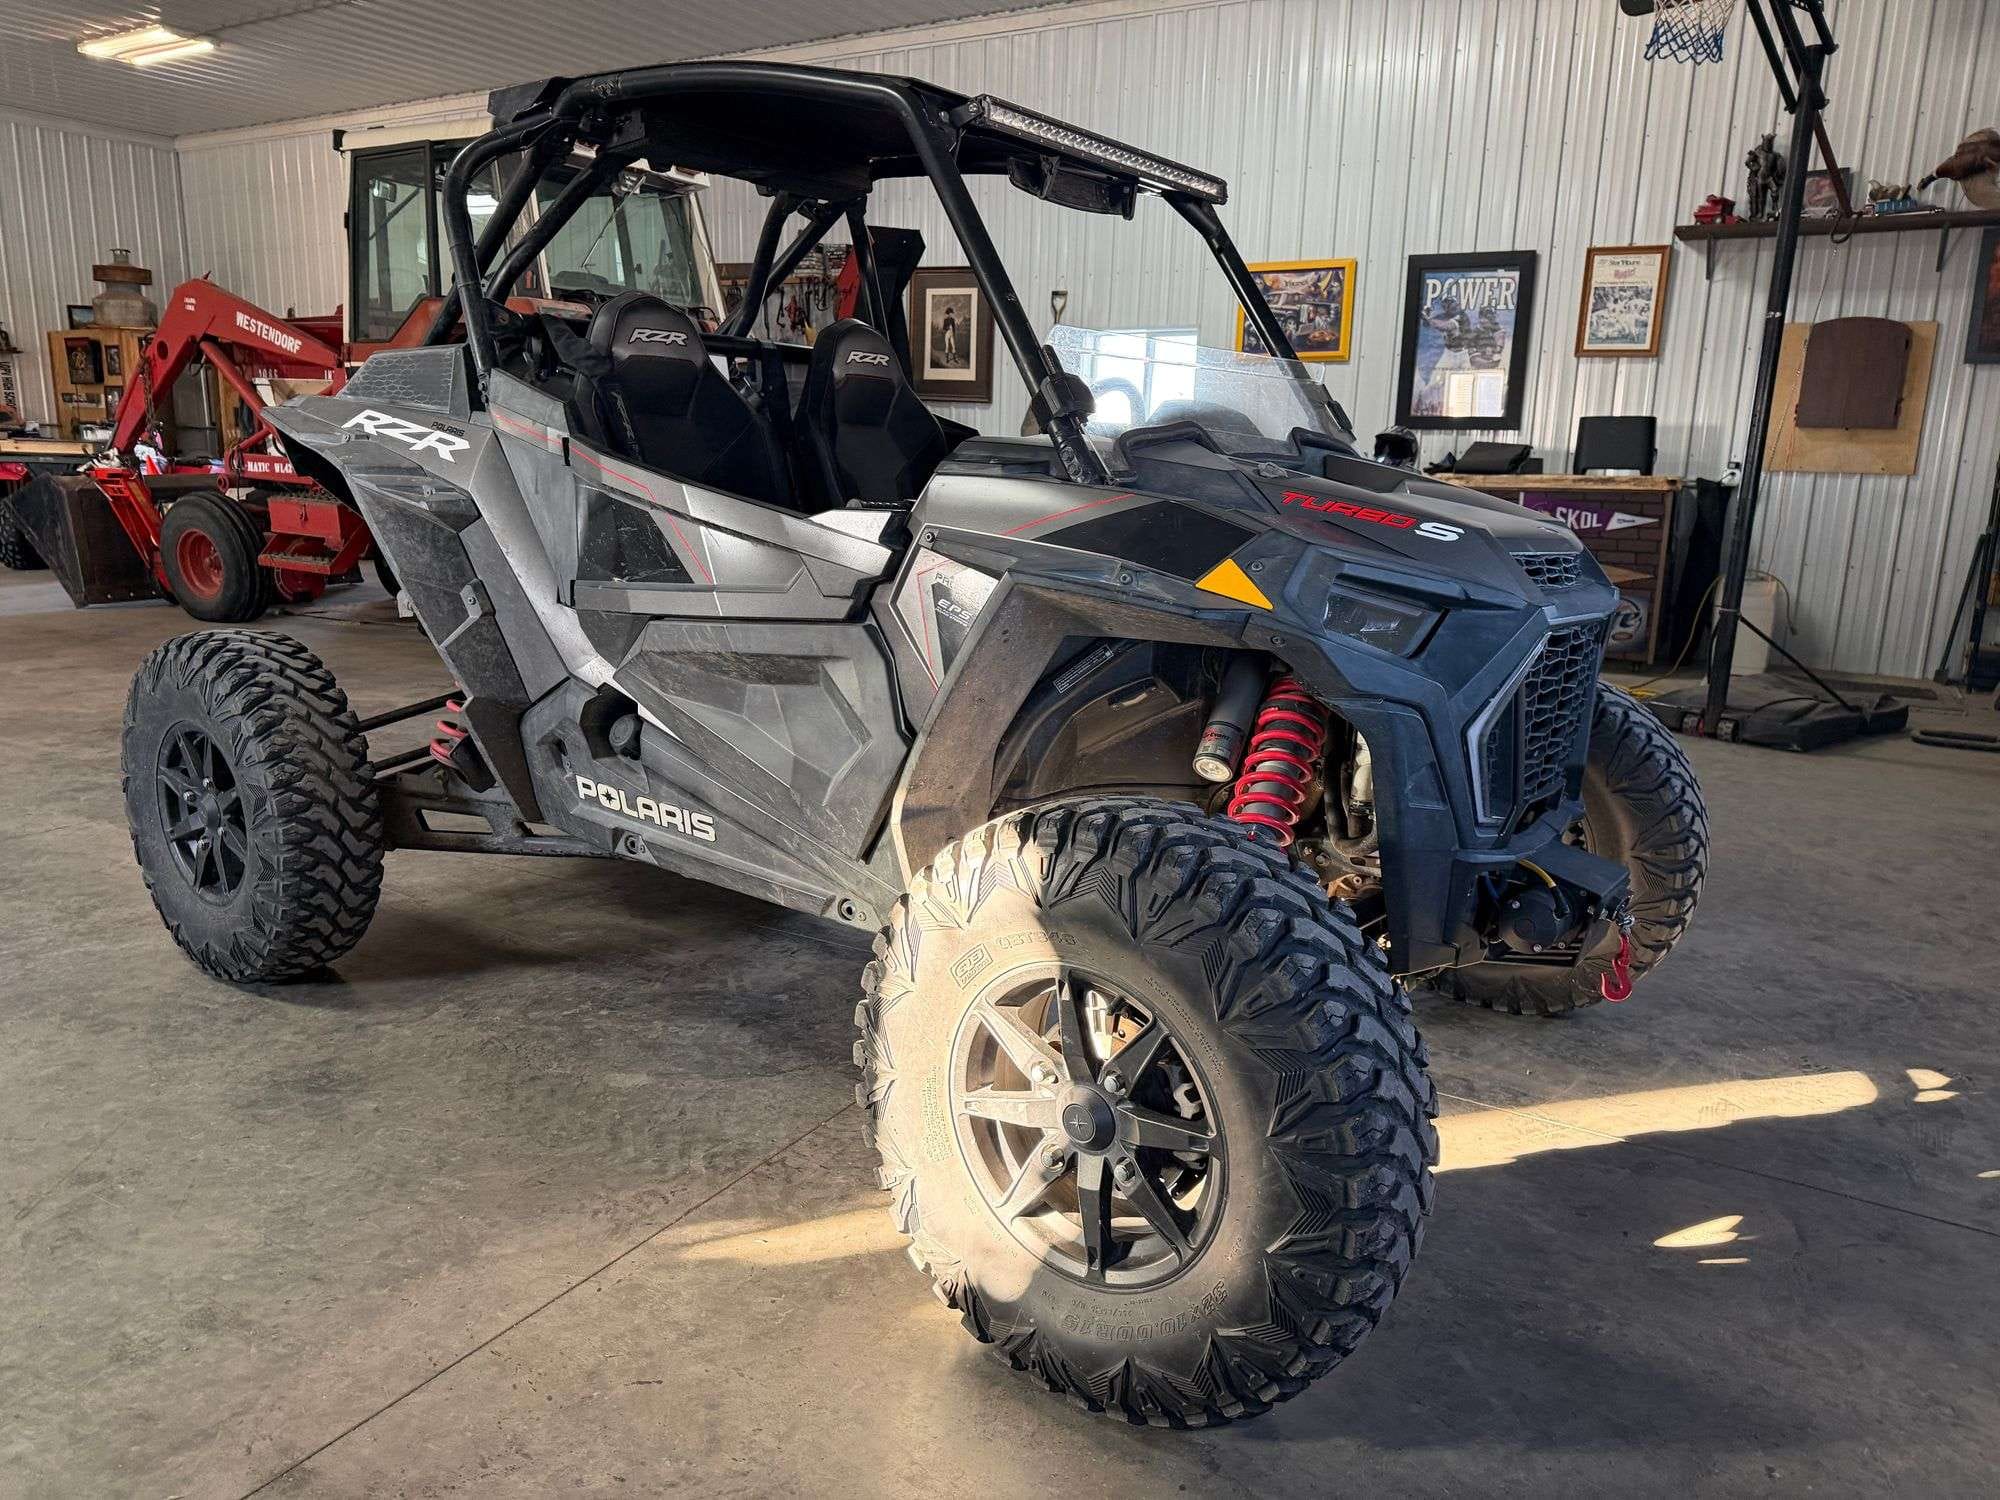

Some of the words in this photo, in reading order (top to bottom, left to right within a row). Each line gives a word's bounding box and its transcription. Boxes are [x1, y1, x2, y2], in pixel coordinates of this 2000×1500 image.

[1425, 277, 1516, 310] POWER
[236, 310, 302, 354] WESTENDORF
[628, 327, 688, 346] RZR
[846, 350, 890, 366] RZR
[341, 409, 471, 463] RZR
[430, 421, 465, 437] POLARIS
[1281, 490, 1418, 530] TURBO
[1414, 522, 1466, 542] S
[1555, 506, 1602, 530] SKOL
[937, 598, 971, 620] EPS
[575, 774, 716, 842] POLARIS
